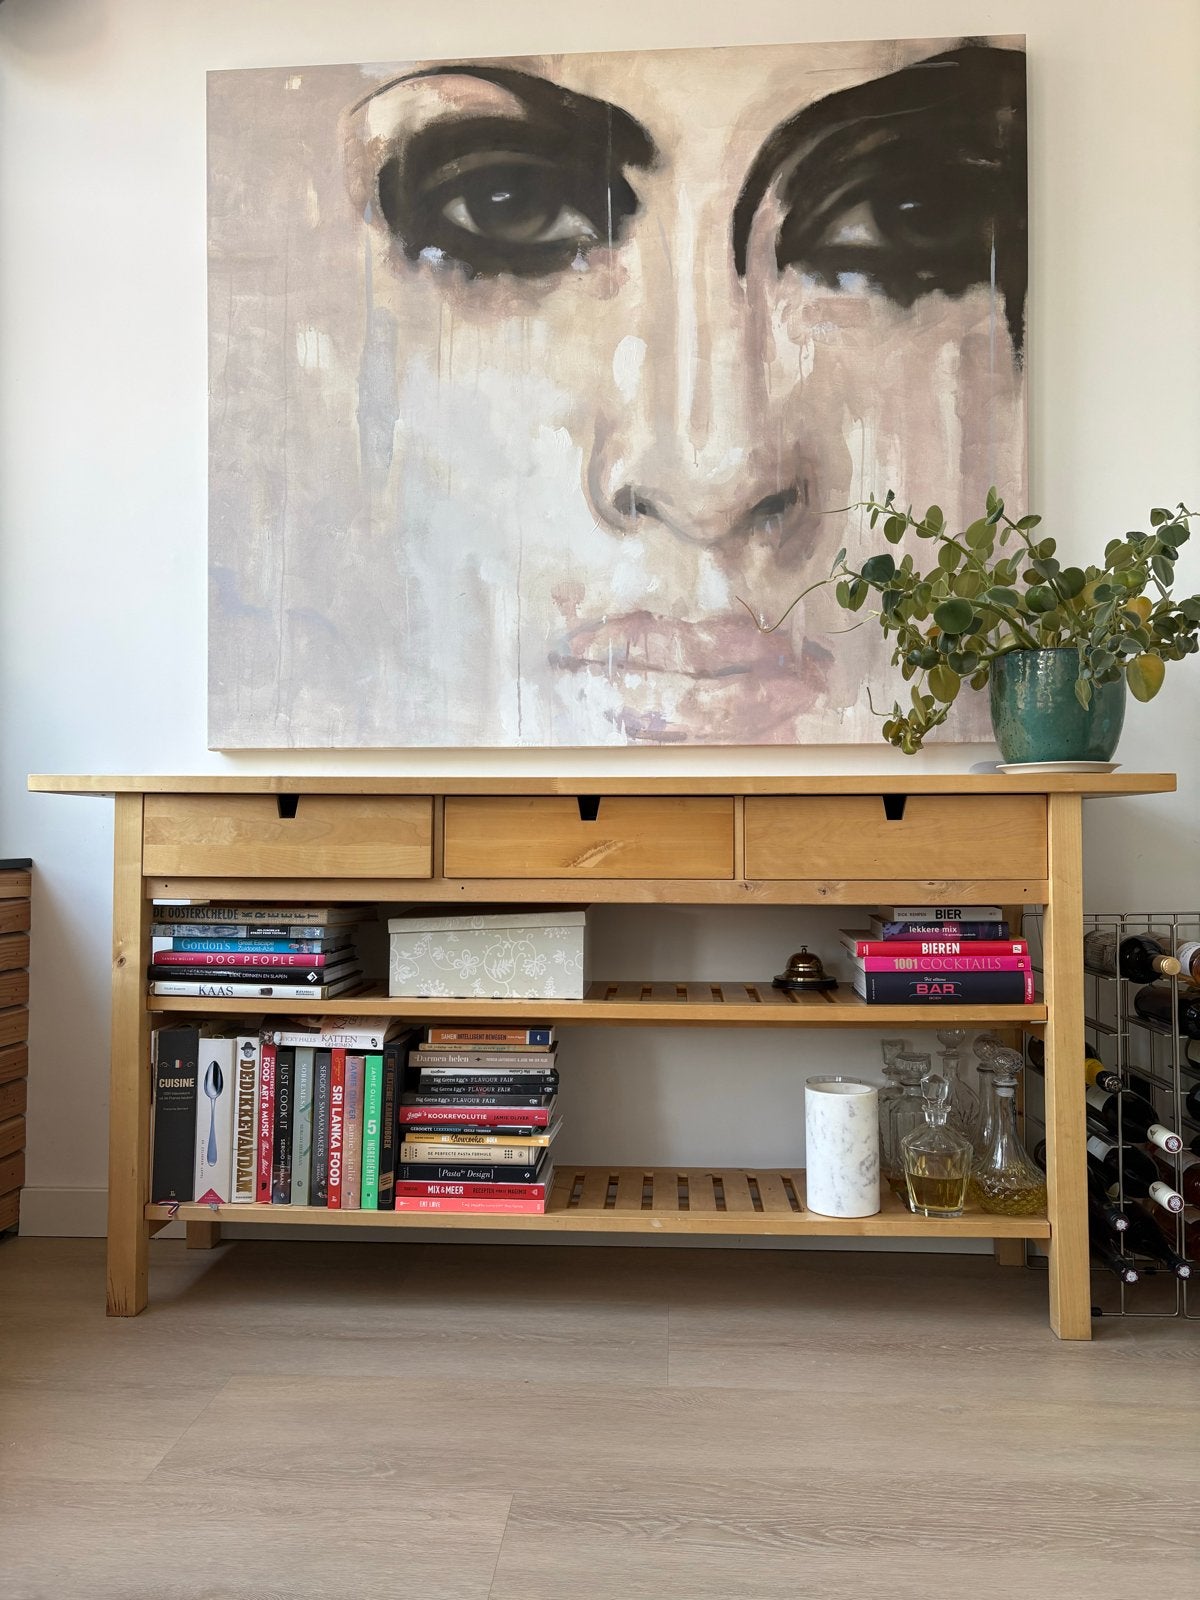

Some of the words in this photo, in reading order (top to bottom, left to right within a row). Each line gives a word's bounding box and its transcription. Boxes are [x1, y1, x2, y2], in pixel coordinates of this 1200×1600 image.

[152, 906, 166, 919] DE
[168, 907, 239, 920] OOSTERSCHELDE
[935, 909, 962, 920] BIER
[909, 925, 940, 934] lekkere
[942, 925, 958, 934] mix
[181, 939, 231, 951] Gordon's
[921, 942, 960, 954] BIEREN
[206, 955, 236, 964] DOG
[243, 955, 295, 965] PEOPLE
[893, 958, 918, 970] 1001
[920, 957, 1001, 970] COCKTAILS
[198, 985, 234, 996] KAAS
[916, 983, 955, 994] BAR
[321, 1034, 358, 1043] KATTEN
[413, 1054, 447, 1063] Darmen
[448, 1055, 469, 1063] helen
[262, 1057, 270, 1082] FOOD
[280, 1063, 289, 1086] JUST
[349, 1060, 357, 1087] JAMIE
[159, 1078, 195, 1088] CUISINE
[299, 1063, 307, 1110] SOBREMESA
[319, 1065, 327, 1099] SERGIO'S
[260, 1084, 269, 1101] ART
[332, 1085, 343, 1105] SRI
[279, 1088, 288, 1118] COOK
[349, 1090, 357, 1120] OLIVER
[261, 1111, 269, 1137] MUSIC
[406, 1111, 428, 1121] Jamie's
[236, 1059, 256, 1193] DEDIKKEVANDAM
[279, 1121, 288, 1130] IT
[317, 1101, 326, 1157] SMAAKMAKERS
[330, 1108, 342, 1148] LANKA
[367, 1119, 377, 1135] 5
[347, 1122, 357, 1155] jamie's
[450, 1134, 485, 1144] Slowcooker
[329, 1152, 340, 1187] FOOD
